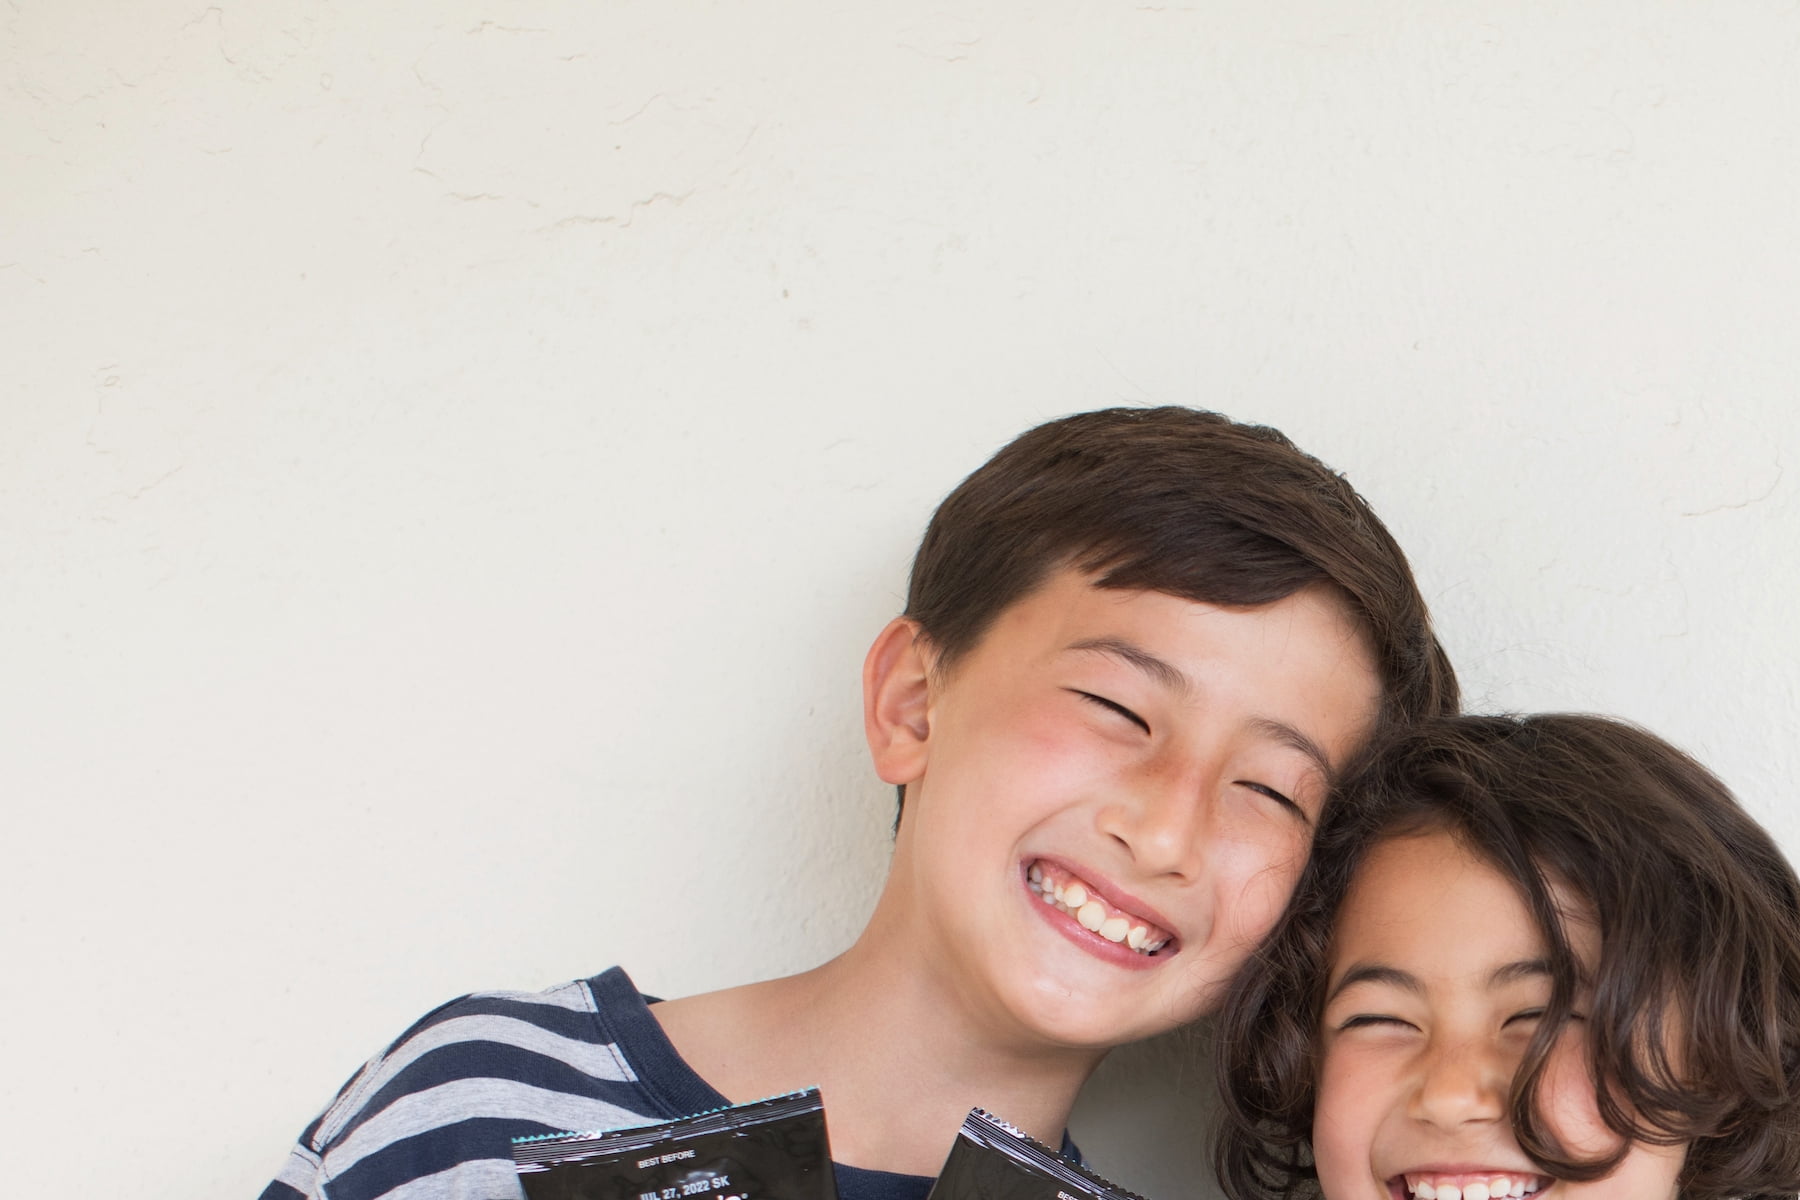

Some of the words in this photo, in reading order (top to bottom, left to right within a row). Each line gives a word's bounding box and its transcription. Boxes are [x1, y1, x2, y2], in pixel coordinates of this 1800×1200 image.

[637, 1156, 660, 1169] BEST
[661, 1149, 696, 1166] BEFORE
[662, 1186, 682, 1200] 27,
[683, 1179, 710, 1197] 2022
[711, 1175, 731, 1190] SK
